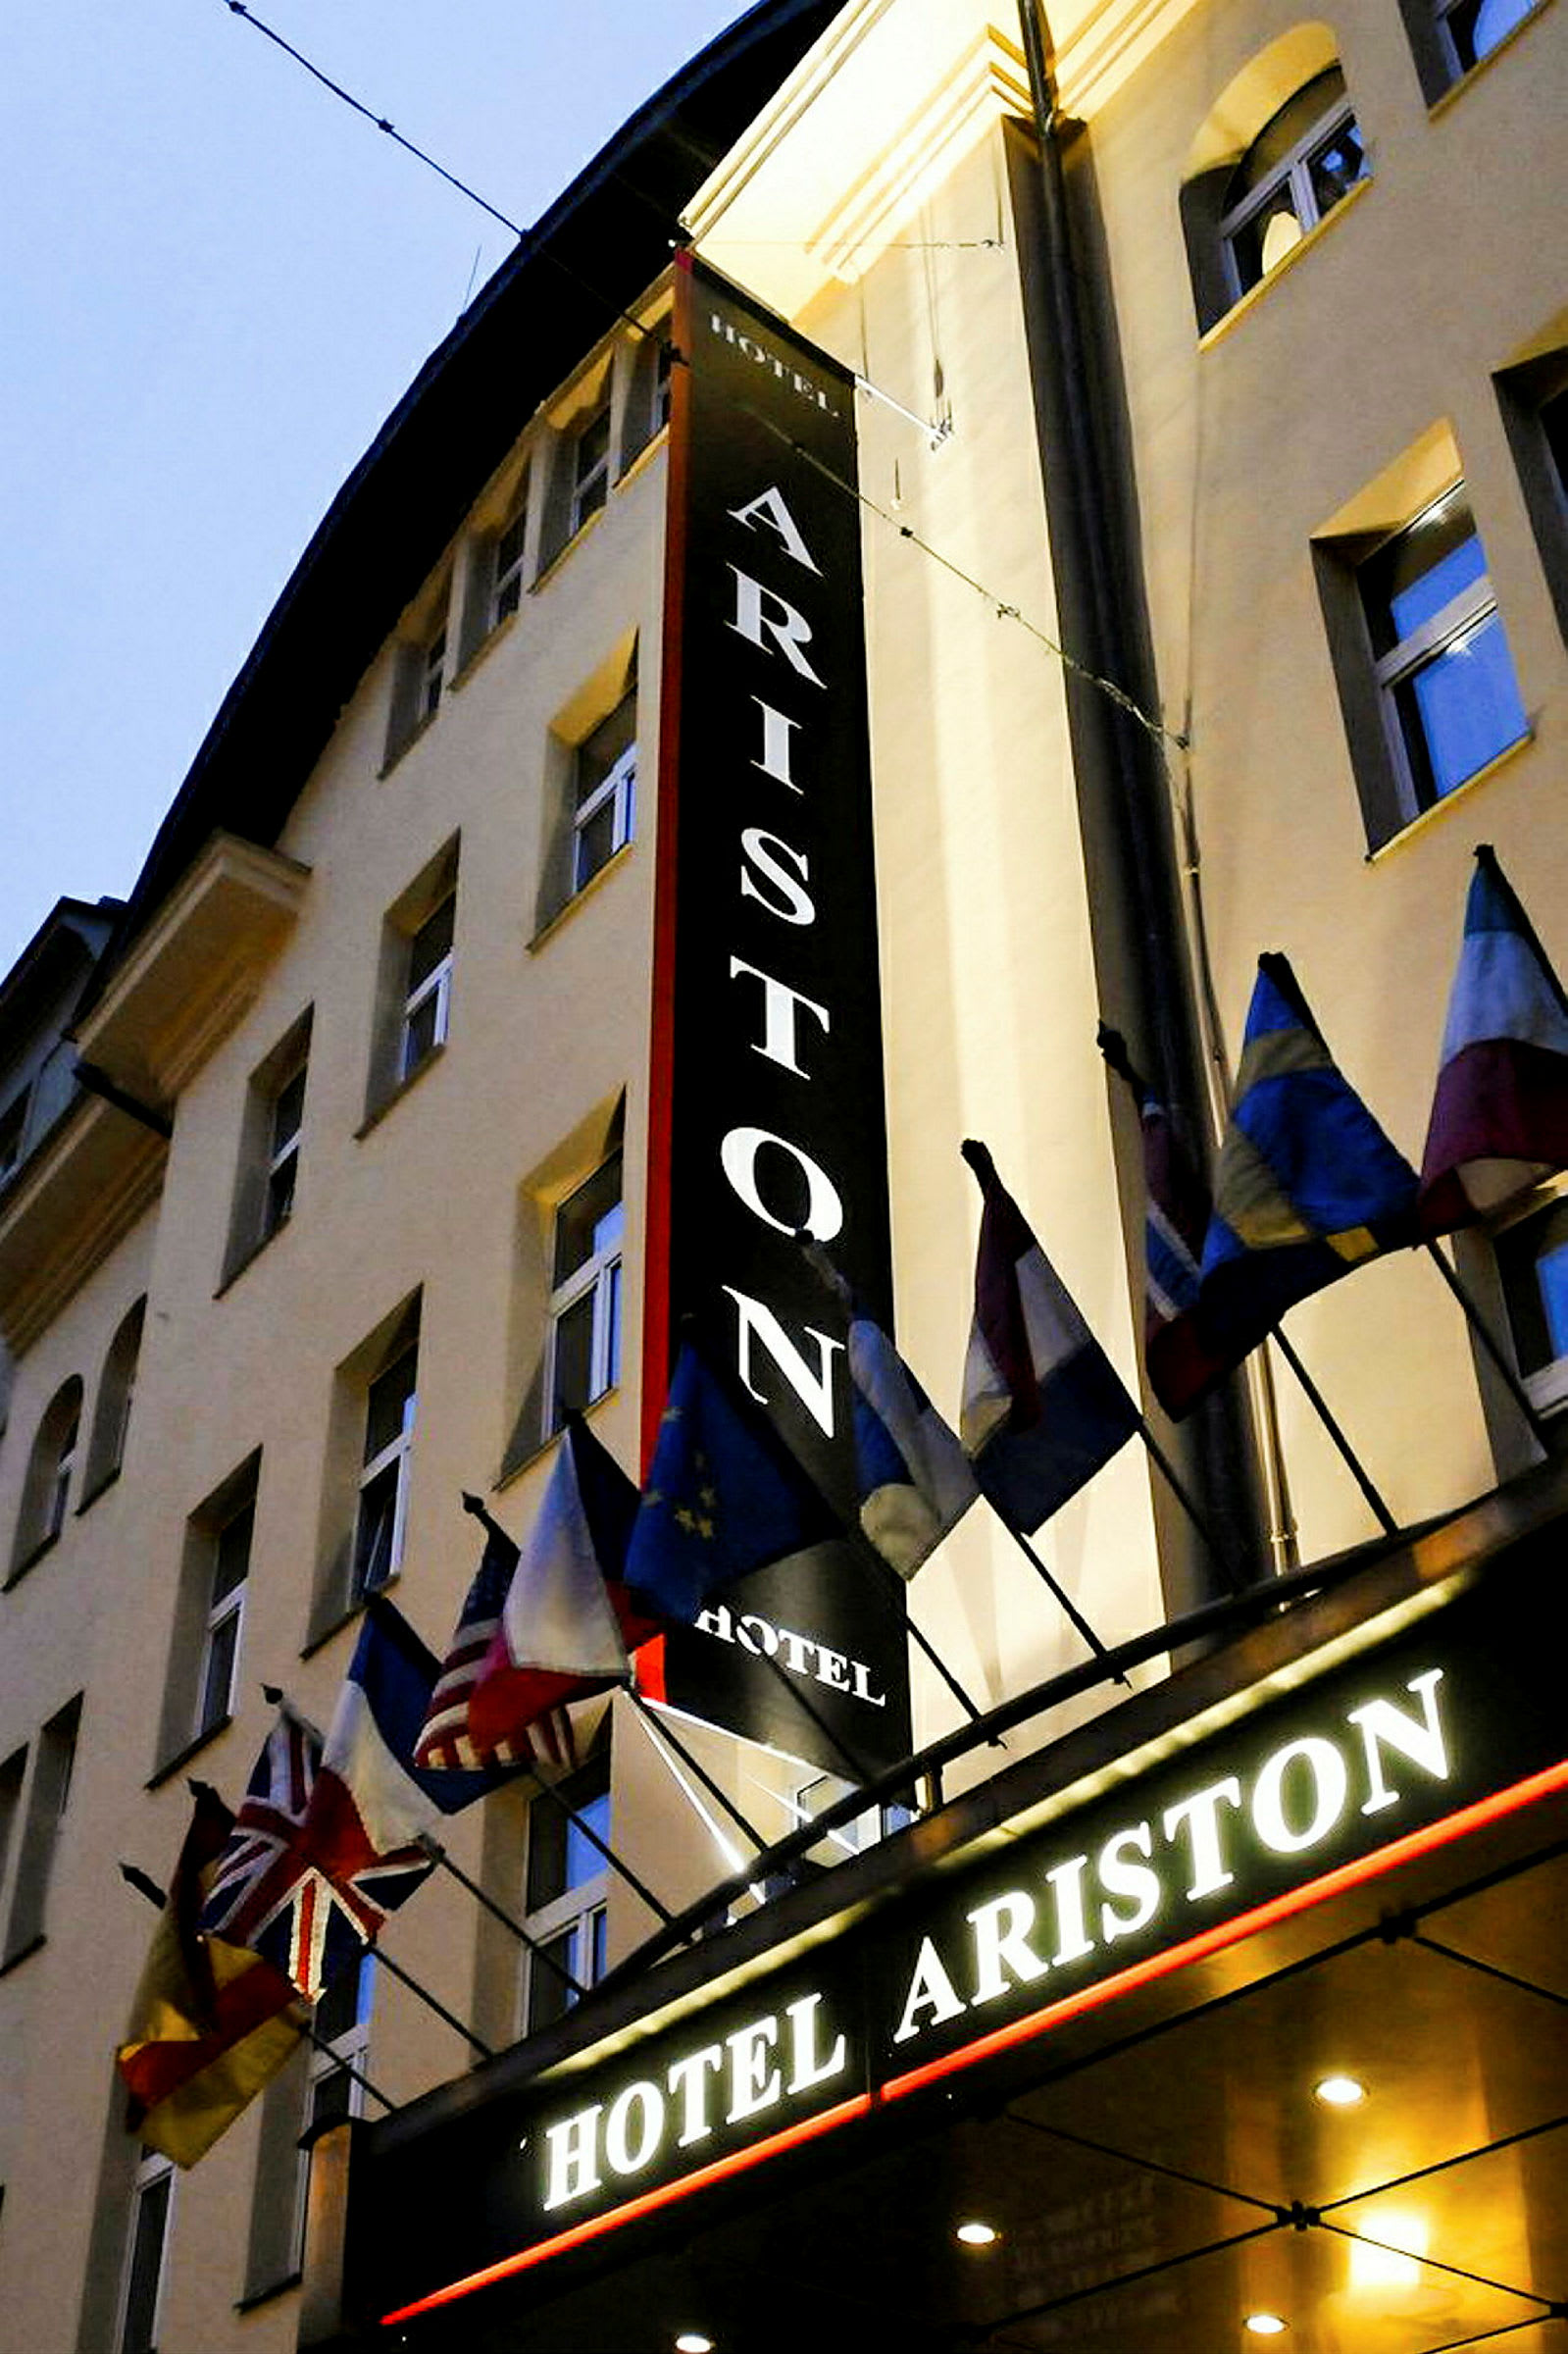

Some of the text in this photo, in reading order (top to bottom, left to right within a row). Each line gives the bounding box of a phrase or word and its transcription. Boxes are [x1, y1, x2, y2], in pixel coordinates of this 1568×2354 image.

[709, 312, 839, 417] HOTEL
[720, 486, 846, 1439] ARISTON
[693, 1605, 886, 1708] HOTEL
[541, 1666, 1453, 2213] HOTEL ARISTON
